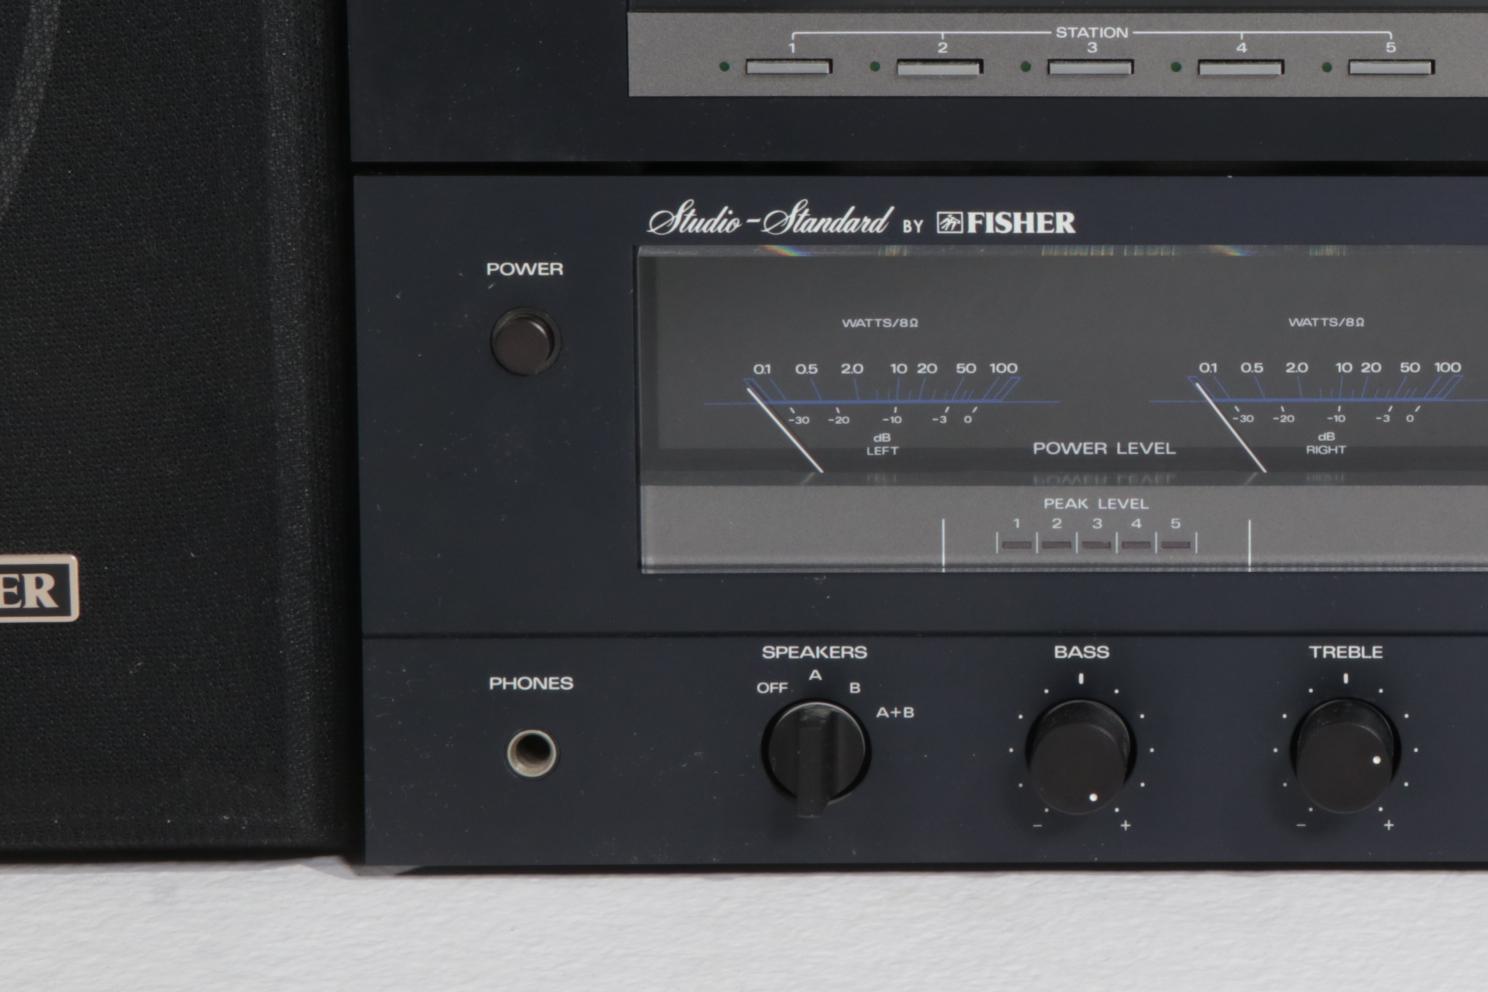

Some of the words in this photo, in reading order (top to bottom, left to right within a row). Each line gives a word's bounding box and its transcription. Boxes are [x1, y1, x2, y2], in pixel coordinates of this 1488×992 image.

[1056, 27, 1128, 38] STATION
[789, 43, 795, 53] 1
[938, 42, 947, 53] 2
[1088, 42, 1097, 53] 3
[1236, 43, 1247, 53] 4
[1386, 42, 1396, 53] 5
[903, 220, 923, 233] BY
[968, 212, 1075, 233] FISHER
[487, 262, 563, 276] POWER
[873, 433, 891, 442] dB
[1318, 432, 1335, 441] dB
[867, 446, 899, 455] LEFT
[1034, 442, 1107, 454] POWER
[1117, 442, 1176, 454] LEVEL
[1306, 445, 1346, 454] RIGHT
[1044, 498, 1088, 509] PEAK
[1098, 498, 1149, 509] LEVEL
[1014, 518, 1019, 528] 1
[1052, 518, 1062, 529] 2
[1093, 518, 1102, 529] 3
[1131, 518, 1142, 528] 4
[1171, 518, 1181, 529] 5
[763, 646, 867, 659] SPEAKERS
[1055, 646, 1109, 659] BASS
[1309, 646, 1383, 658] TREBLE
[809, 670, 822, 680] A
[490, 677, 573, 690] PHONES
[757, 682, 788, 693] OFF
[850, 682, 860, 693] B
[876, 707, 914, 718] A+B
